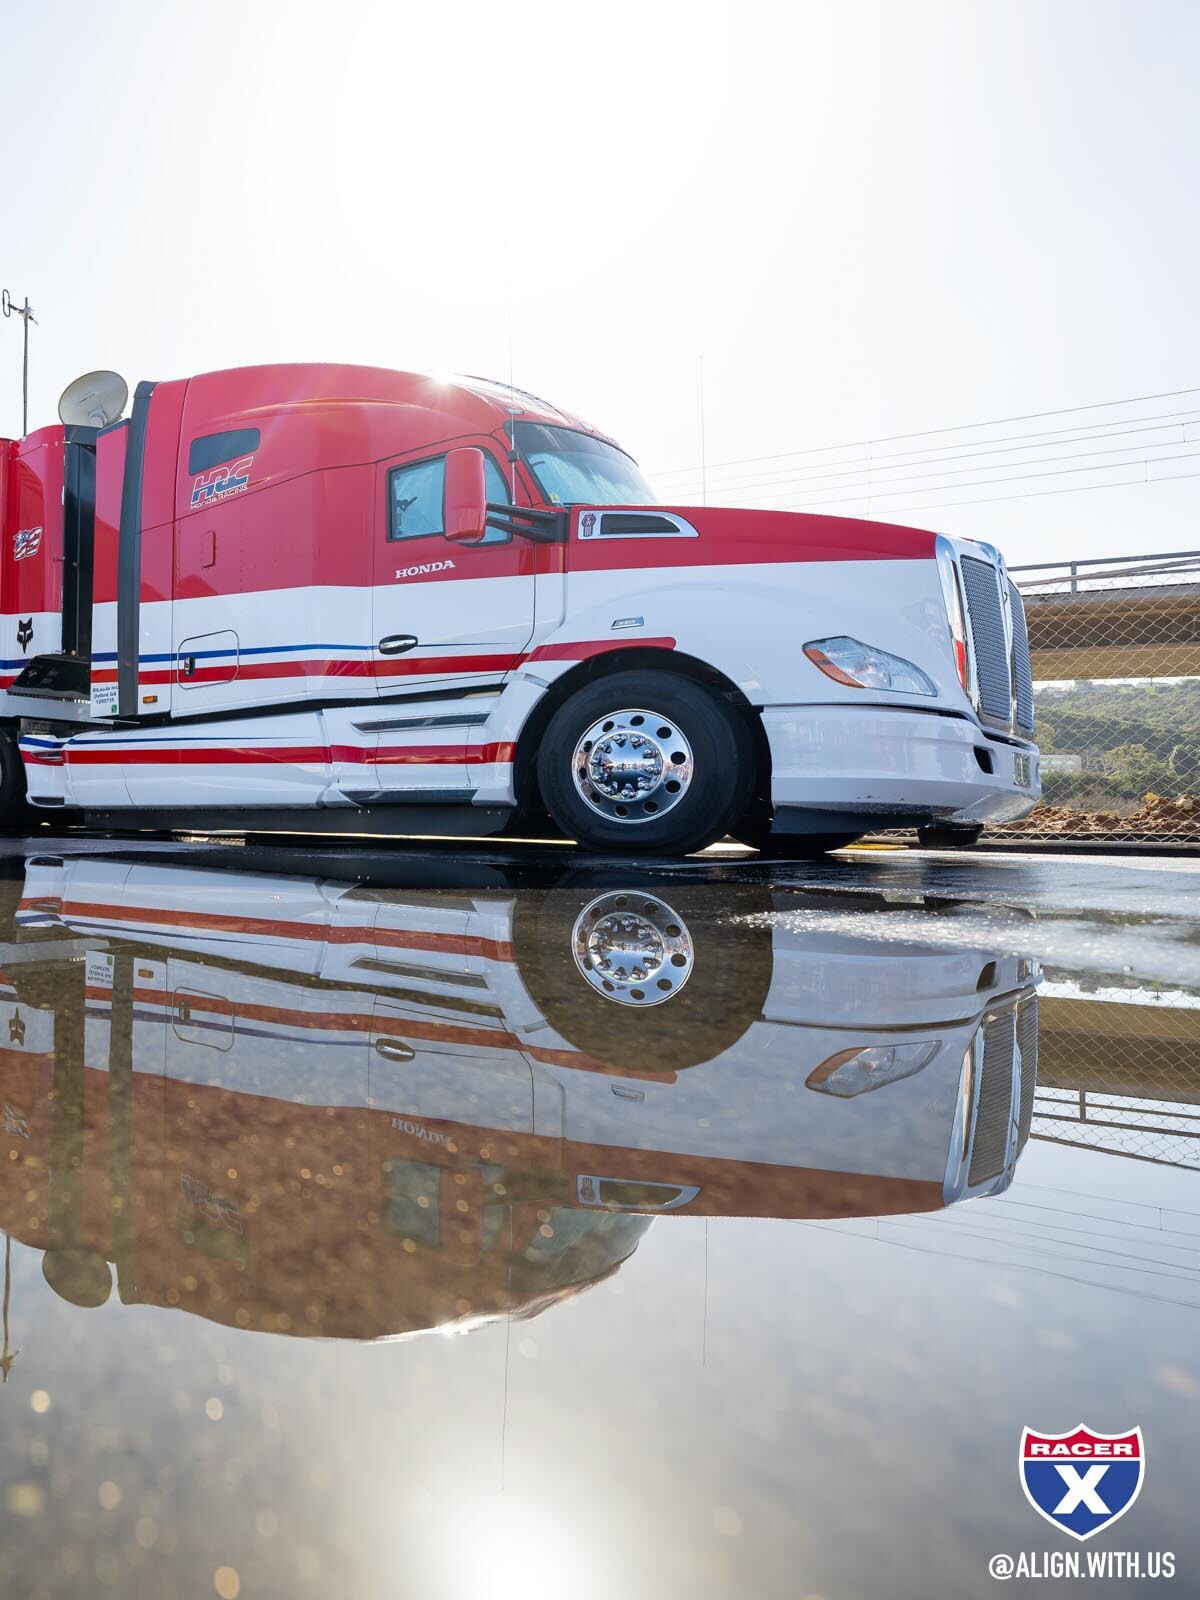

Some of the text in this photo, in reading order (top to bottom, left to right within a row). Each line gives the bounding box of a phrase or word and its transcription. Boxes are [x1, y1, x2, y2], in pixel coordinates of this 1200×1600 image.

[191, 456, 254, 504] HRC
[218, 485, 248, 500] RACING
[395, 560, 456, 579] HONDA
